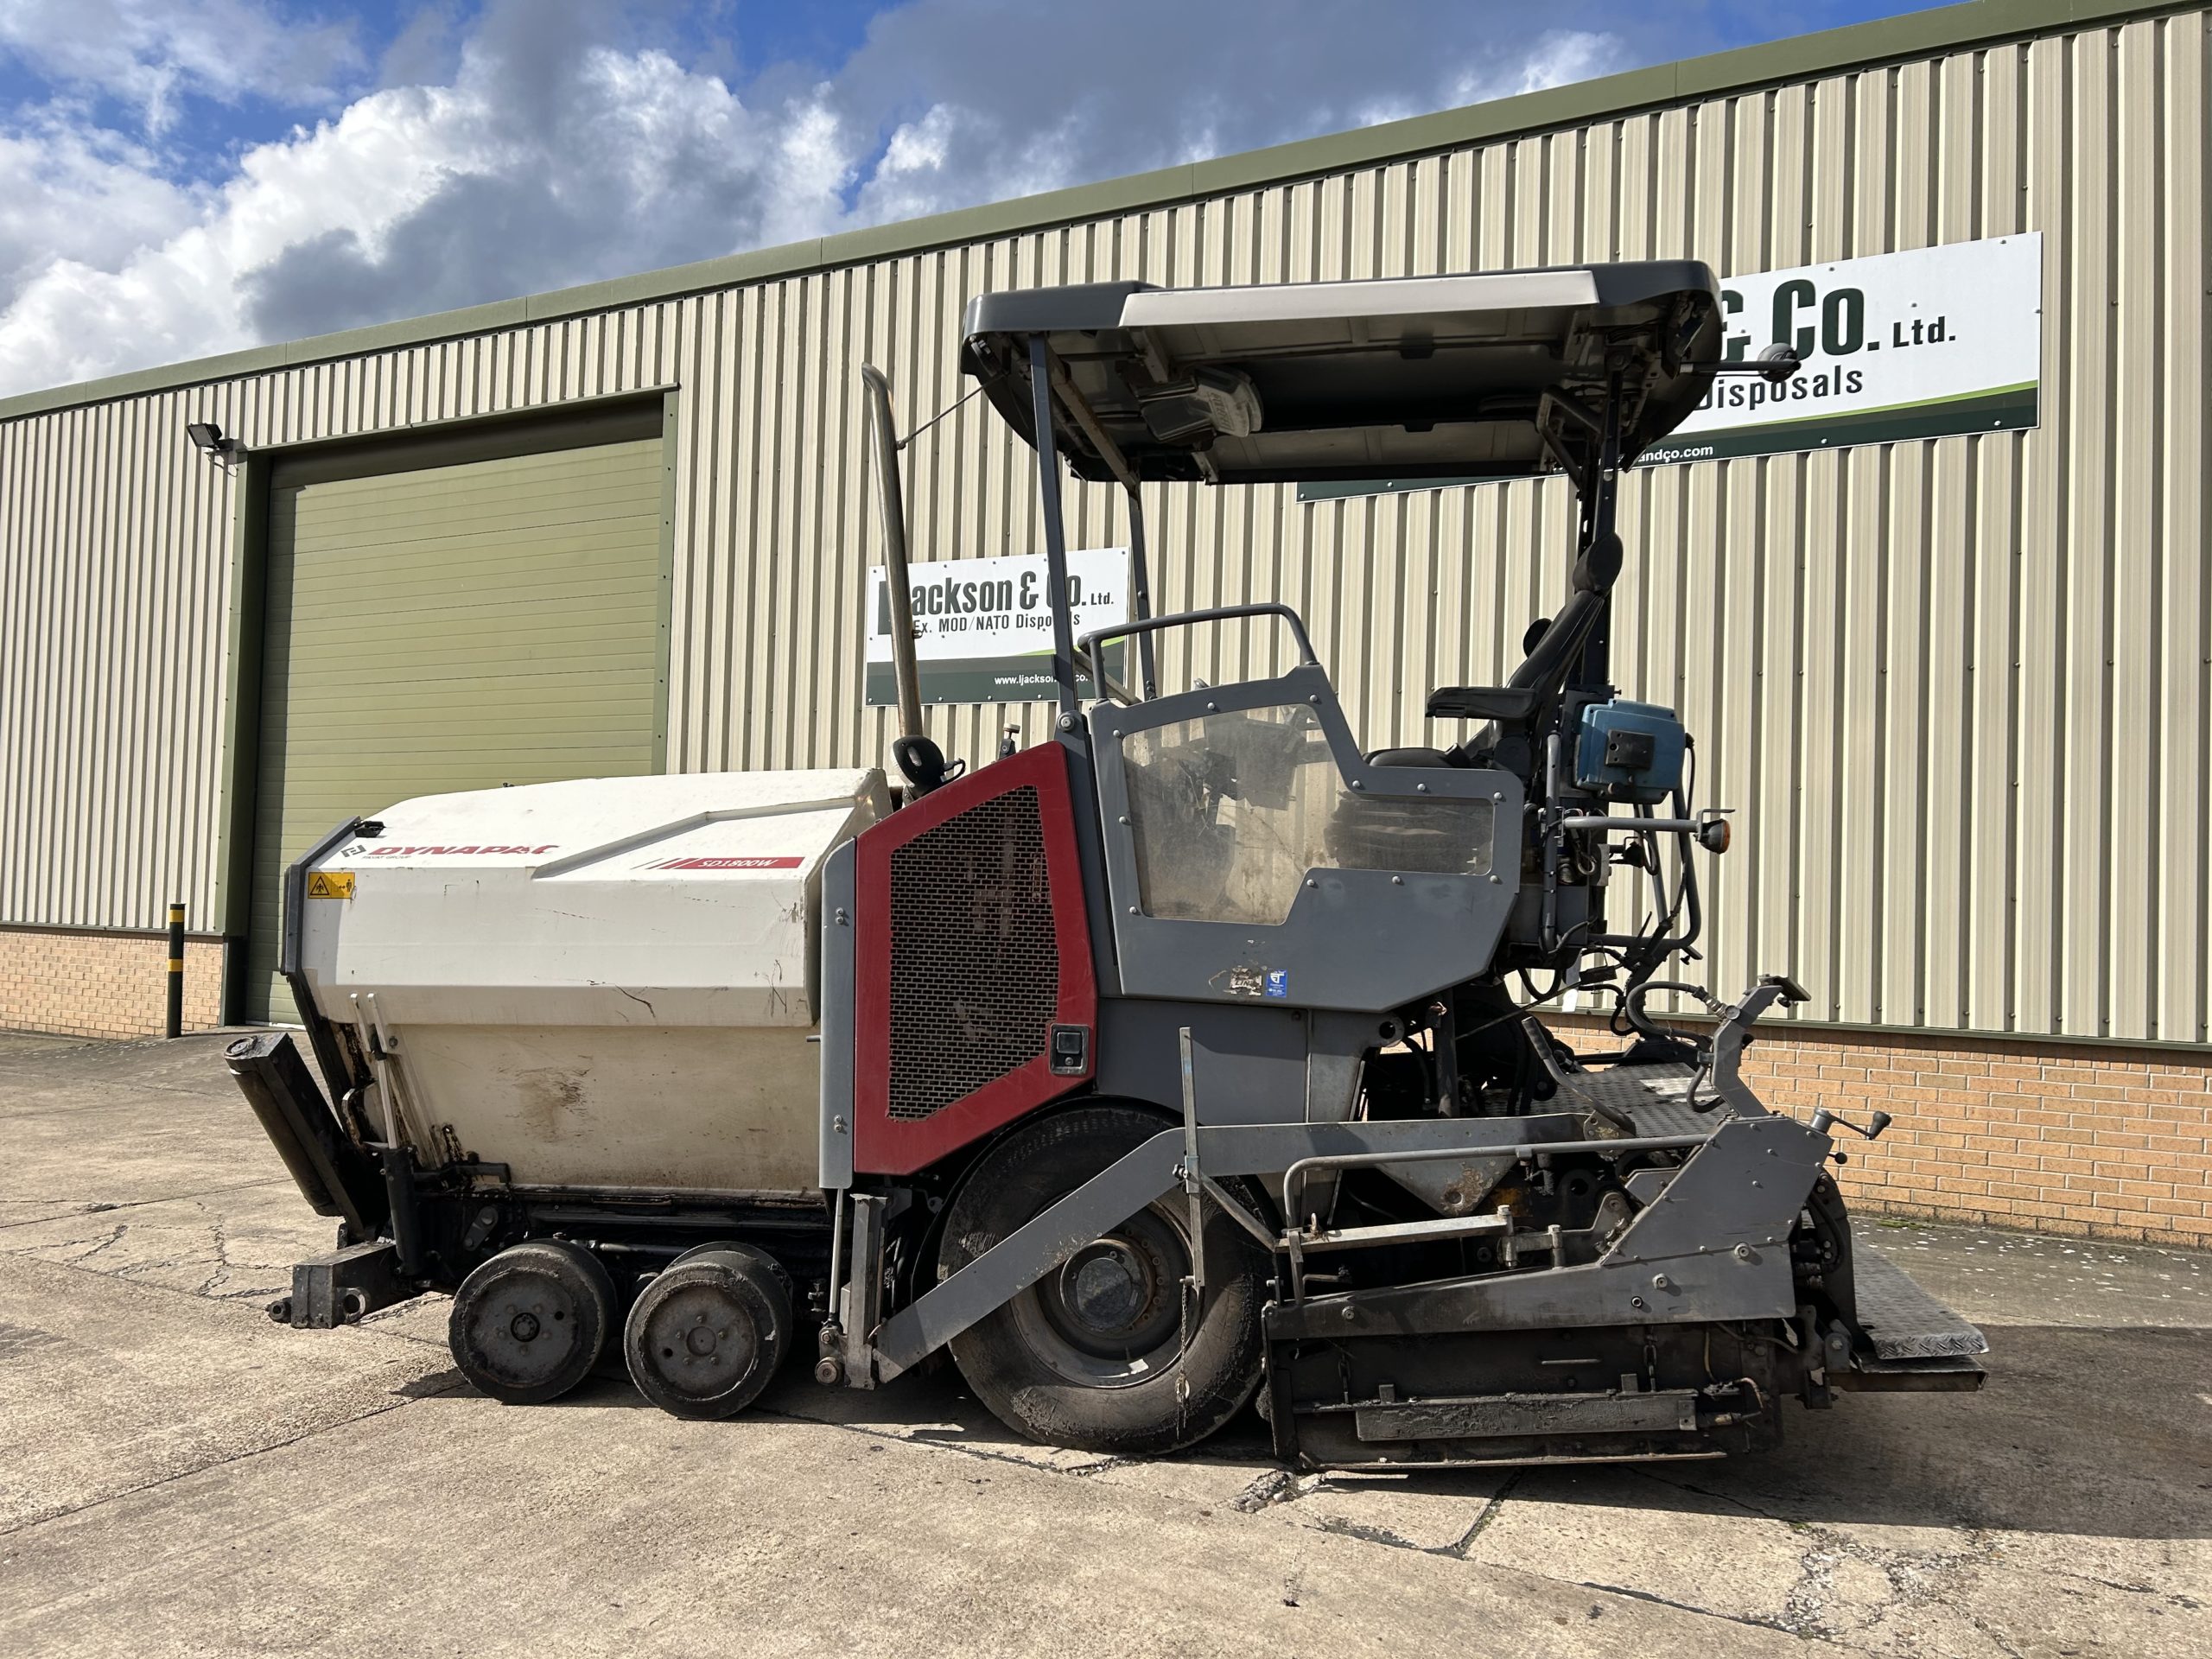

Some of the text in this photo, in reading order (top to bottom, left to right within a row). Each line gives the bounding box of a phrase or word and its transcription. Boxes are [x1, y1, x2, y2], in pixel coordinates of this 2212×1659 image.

[1771, 279, 1880, 361] Co.
[1893, 316, 1956, 348] Ltd.
[912, 577, 1012, 616] ackson
[1020, 570, 1039, 610] &
[1090, 592, 1115, 606] Ltd.
[913, 613, 1080, 634] Ex. MOD/NATO Dispos
[367, 845, 561, 855] DYNAPAC
[698, 859, 779, 868] SD1800W
